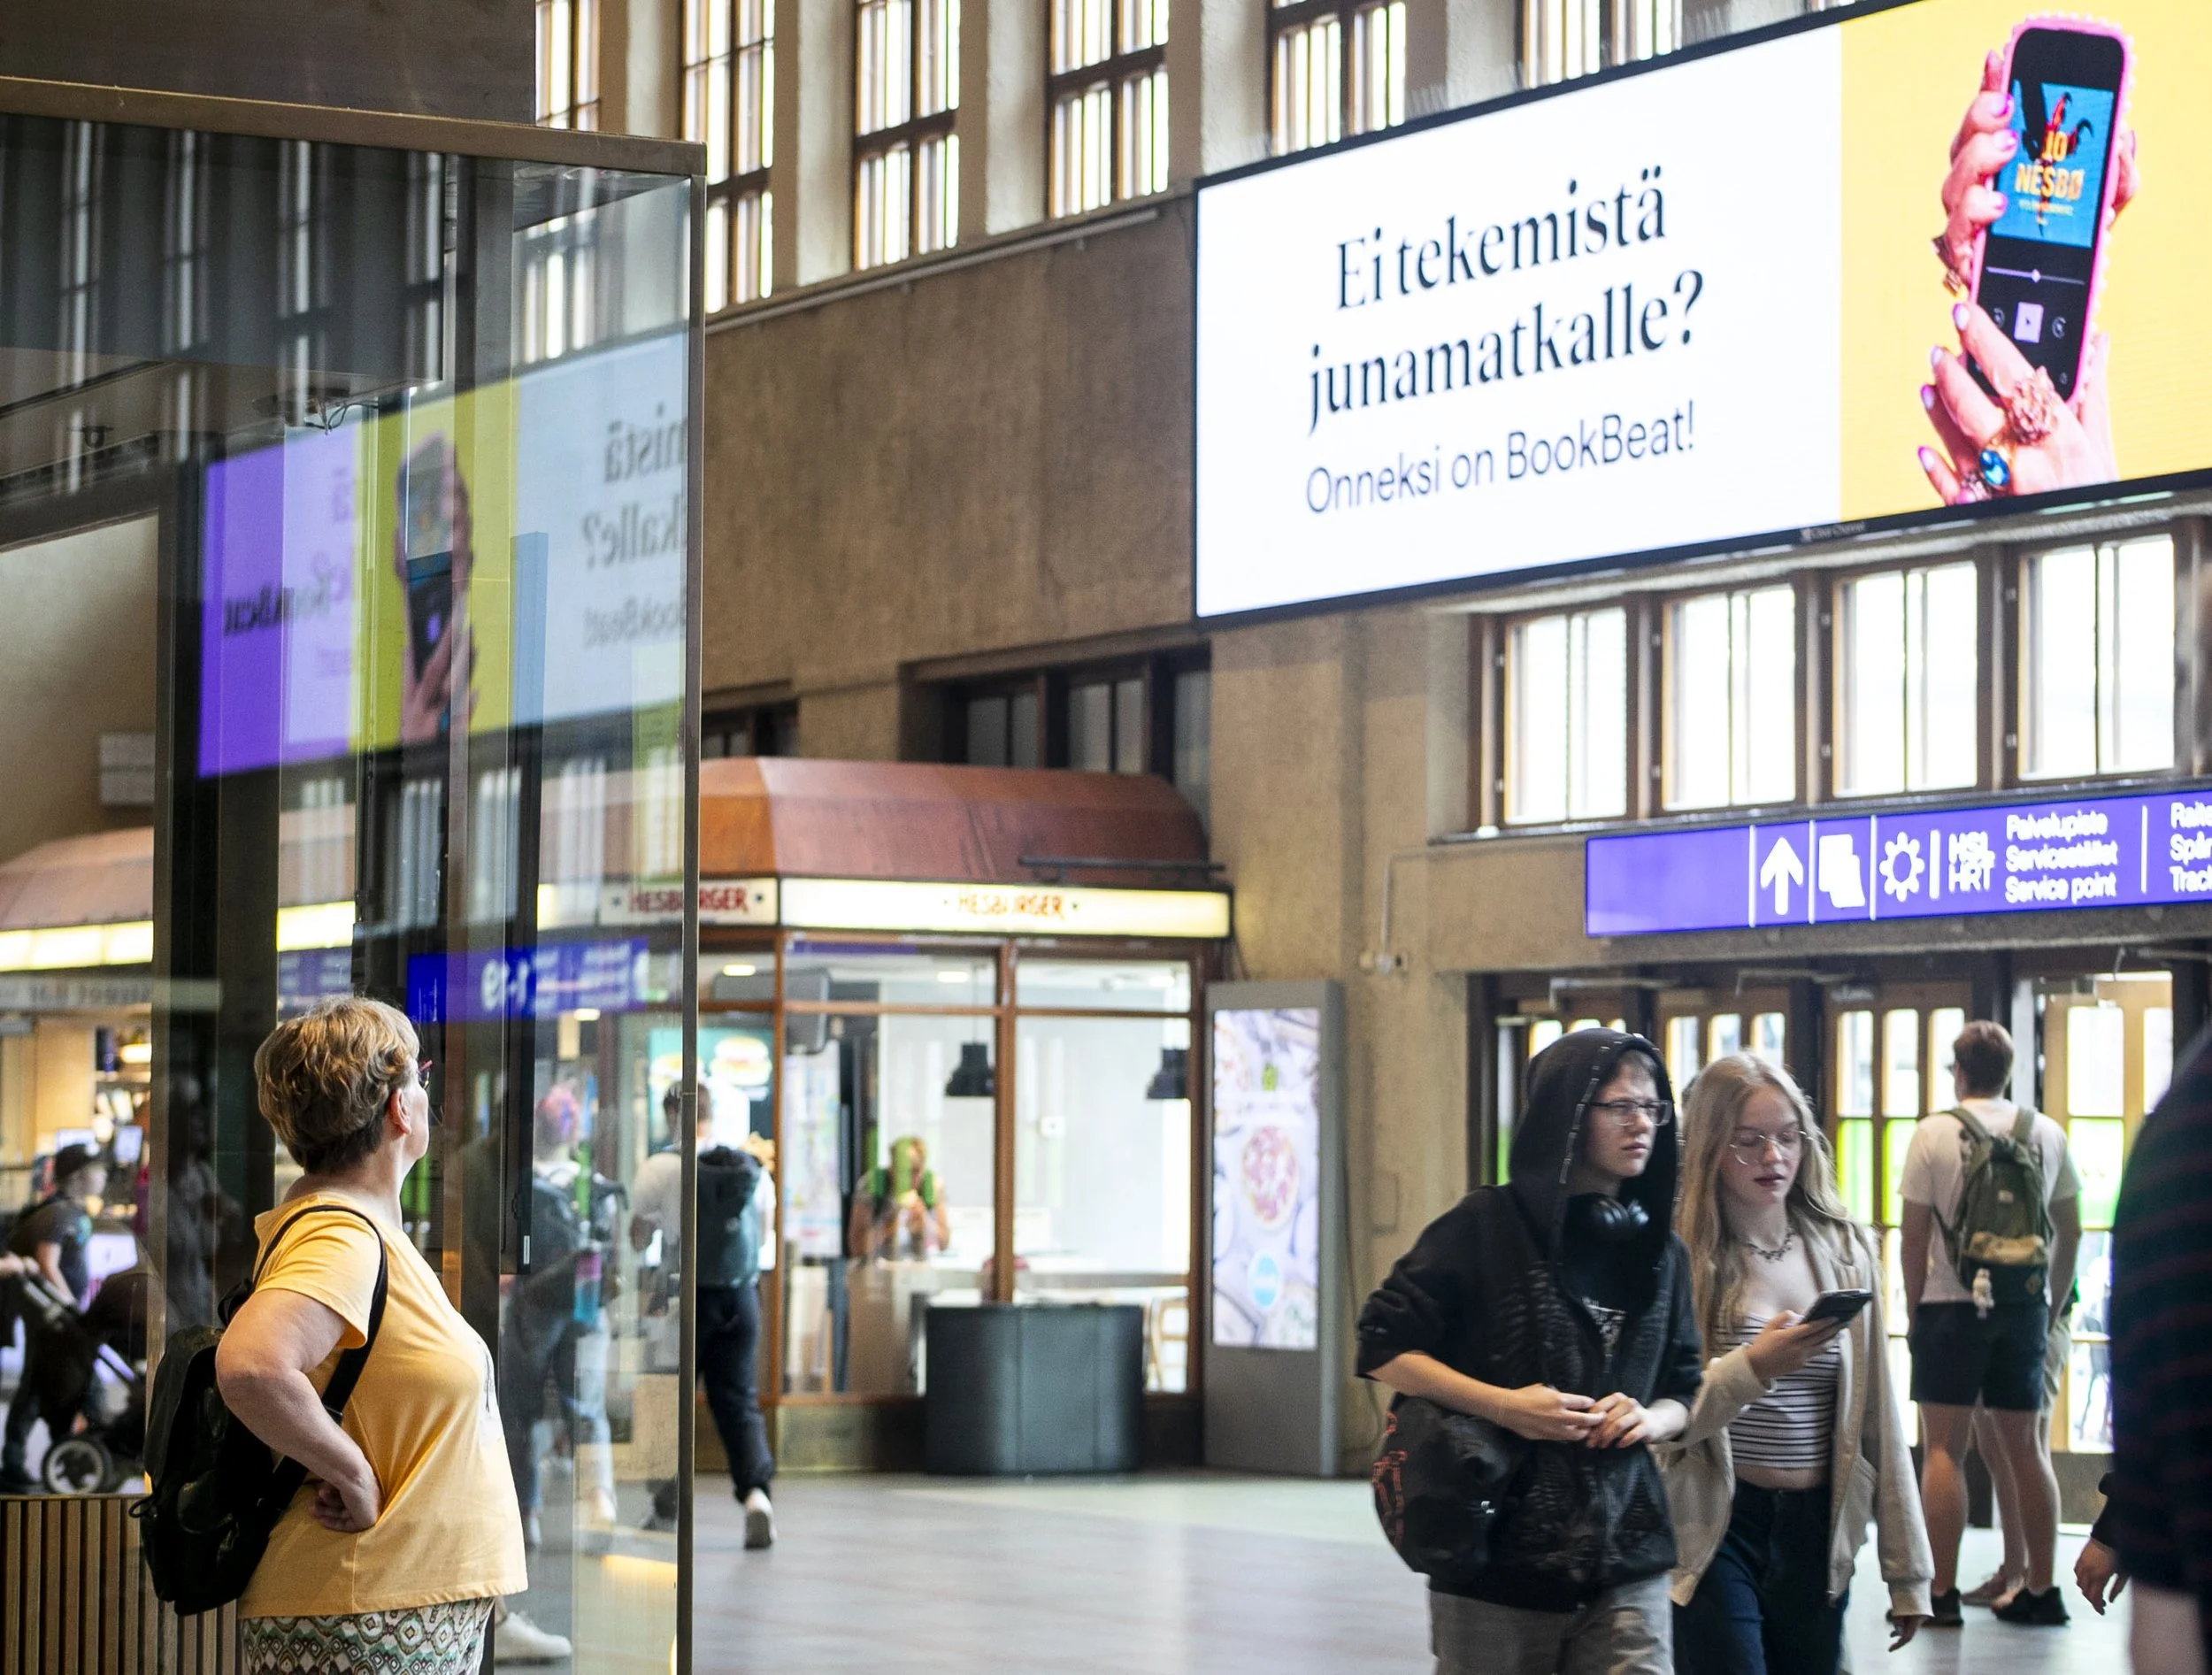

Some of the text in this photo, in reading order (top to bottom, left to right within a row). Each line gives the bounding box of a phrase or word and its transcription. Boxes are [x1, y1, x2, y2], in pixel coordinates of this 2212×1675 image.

[2016, 163, 2085, 201] NESBØ
[2041, 130, 2068, 162] JO
[1335, 165, 1667, 310] Ei tekemistä
[1308, 268, 1705, 437] junamatkalle?
[1306, 398, 1695, 514] Onneksi on BookBeat!
[2005, 872, 2117, 904] Service point
